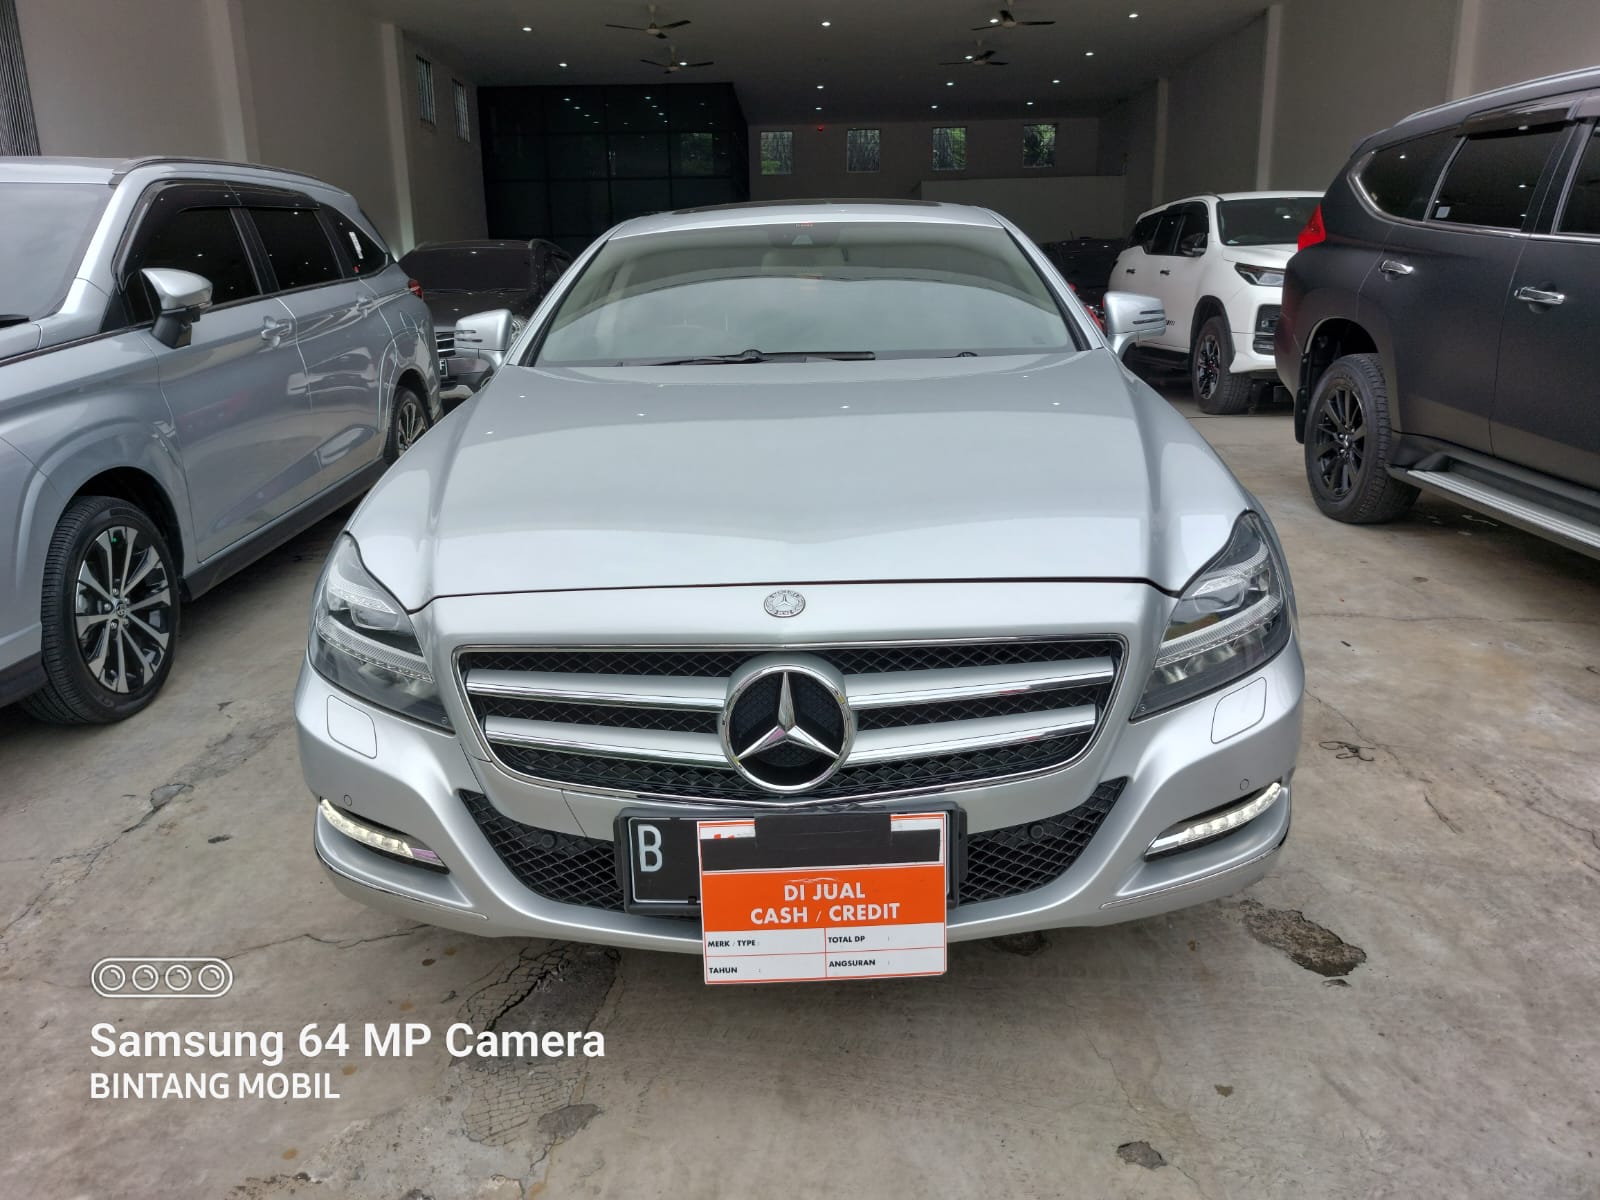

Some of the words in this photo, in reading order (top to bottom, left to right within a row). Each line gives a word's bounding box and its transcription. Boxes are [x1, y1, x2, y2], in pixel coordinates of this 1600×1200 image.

[637, 824, 663, 872] B
[784, 884, 805, 901] DI
[812, 882, 866, 901] JUAL
[750, 905, 808, 925] CASH
[829, 902, 901, 922] CREDIT
[707, 940, 730, 948] MERK
[737, 939, 756, 947] TYPE
[828, 936, 853, 944] TOTAL
[854, 935, 866, 943] DP
[828, 959, 876, 968] ANGSURAN
